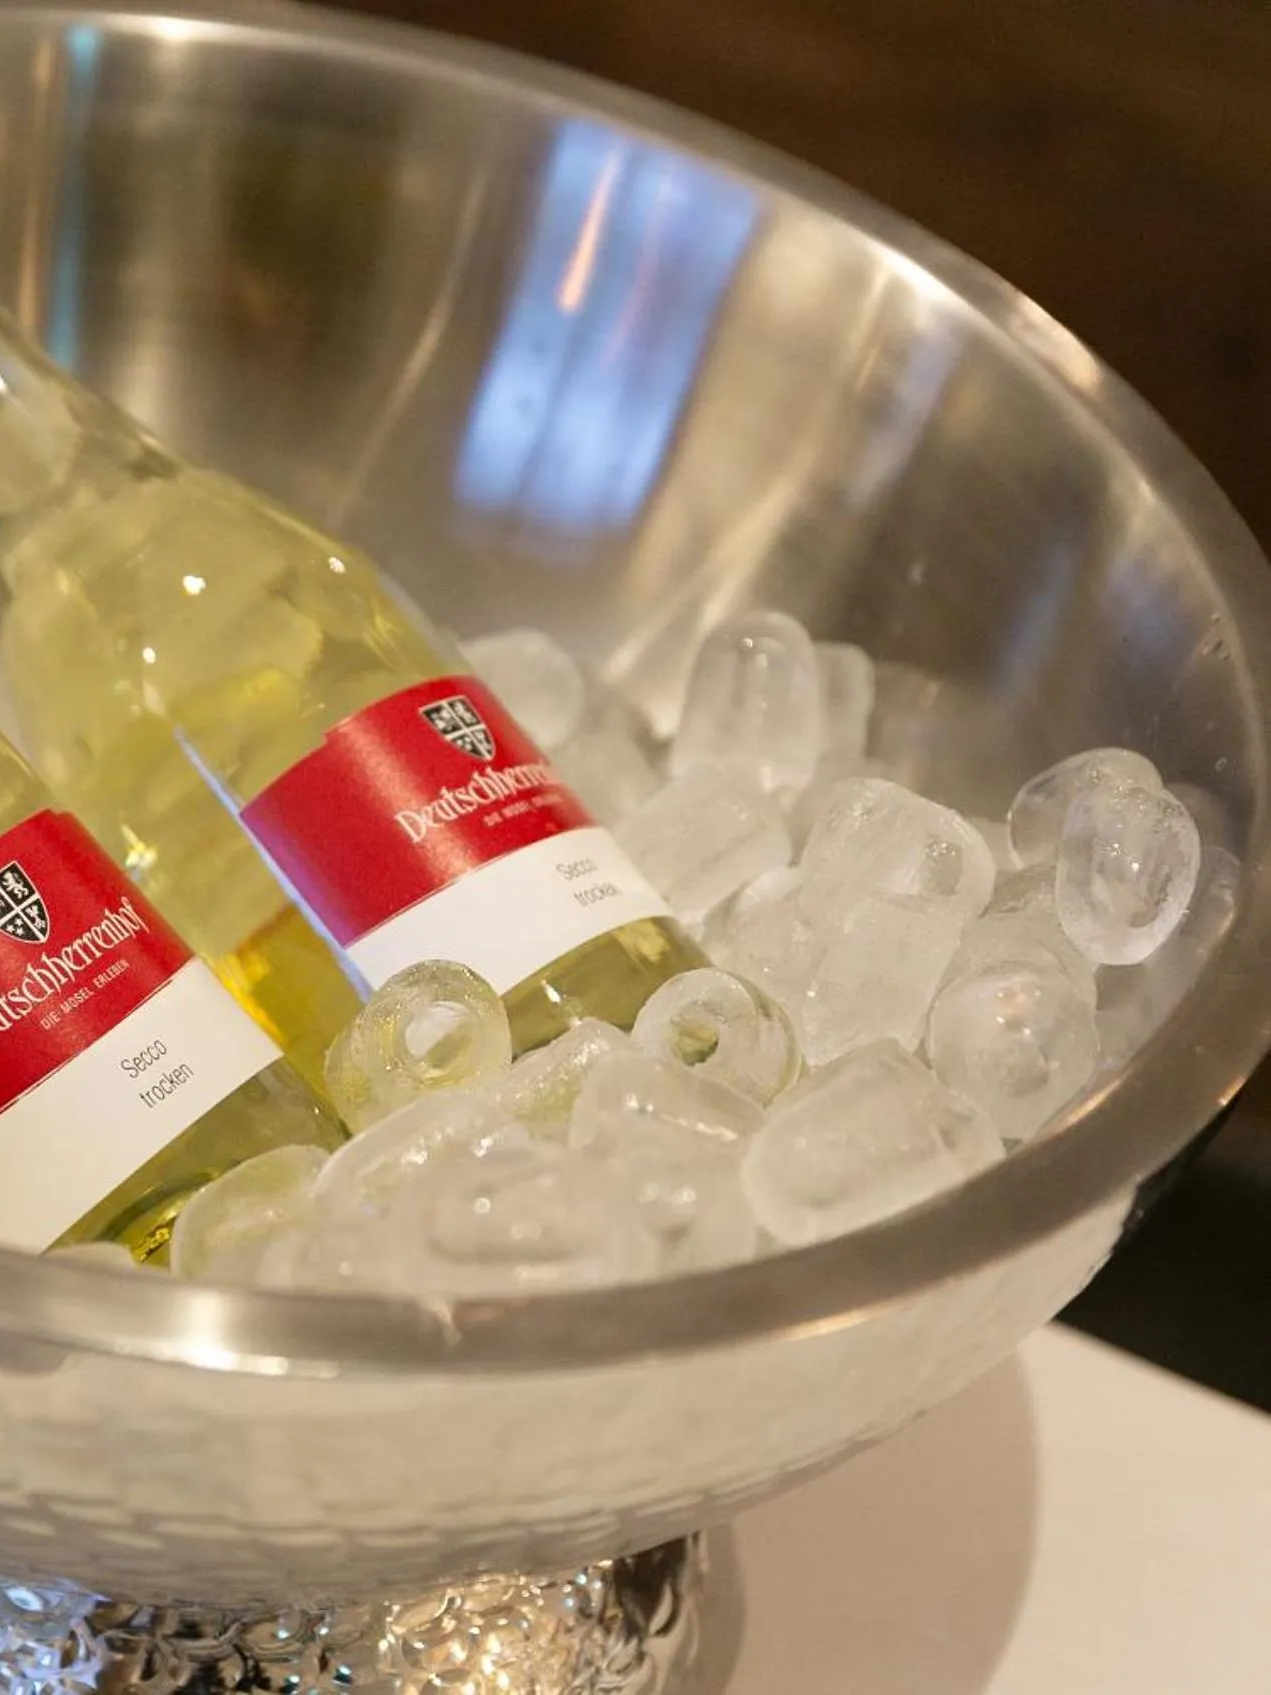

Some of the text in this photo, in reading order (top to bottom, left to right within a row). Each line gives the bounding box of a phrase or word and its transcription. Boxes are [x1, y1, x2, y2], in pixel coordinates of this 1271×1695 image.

[40, 1011, 61, 1030] DIE
[121, 1039, 167, 1079] Secco
[139, 1063, 194, 1109] trocken
